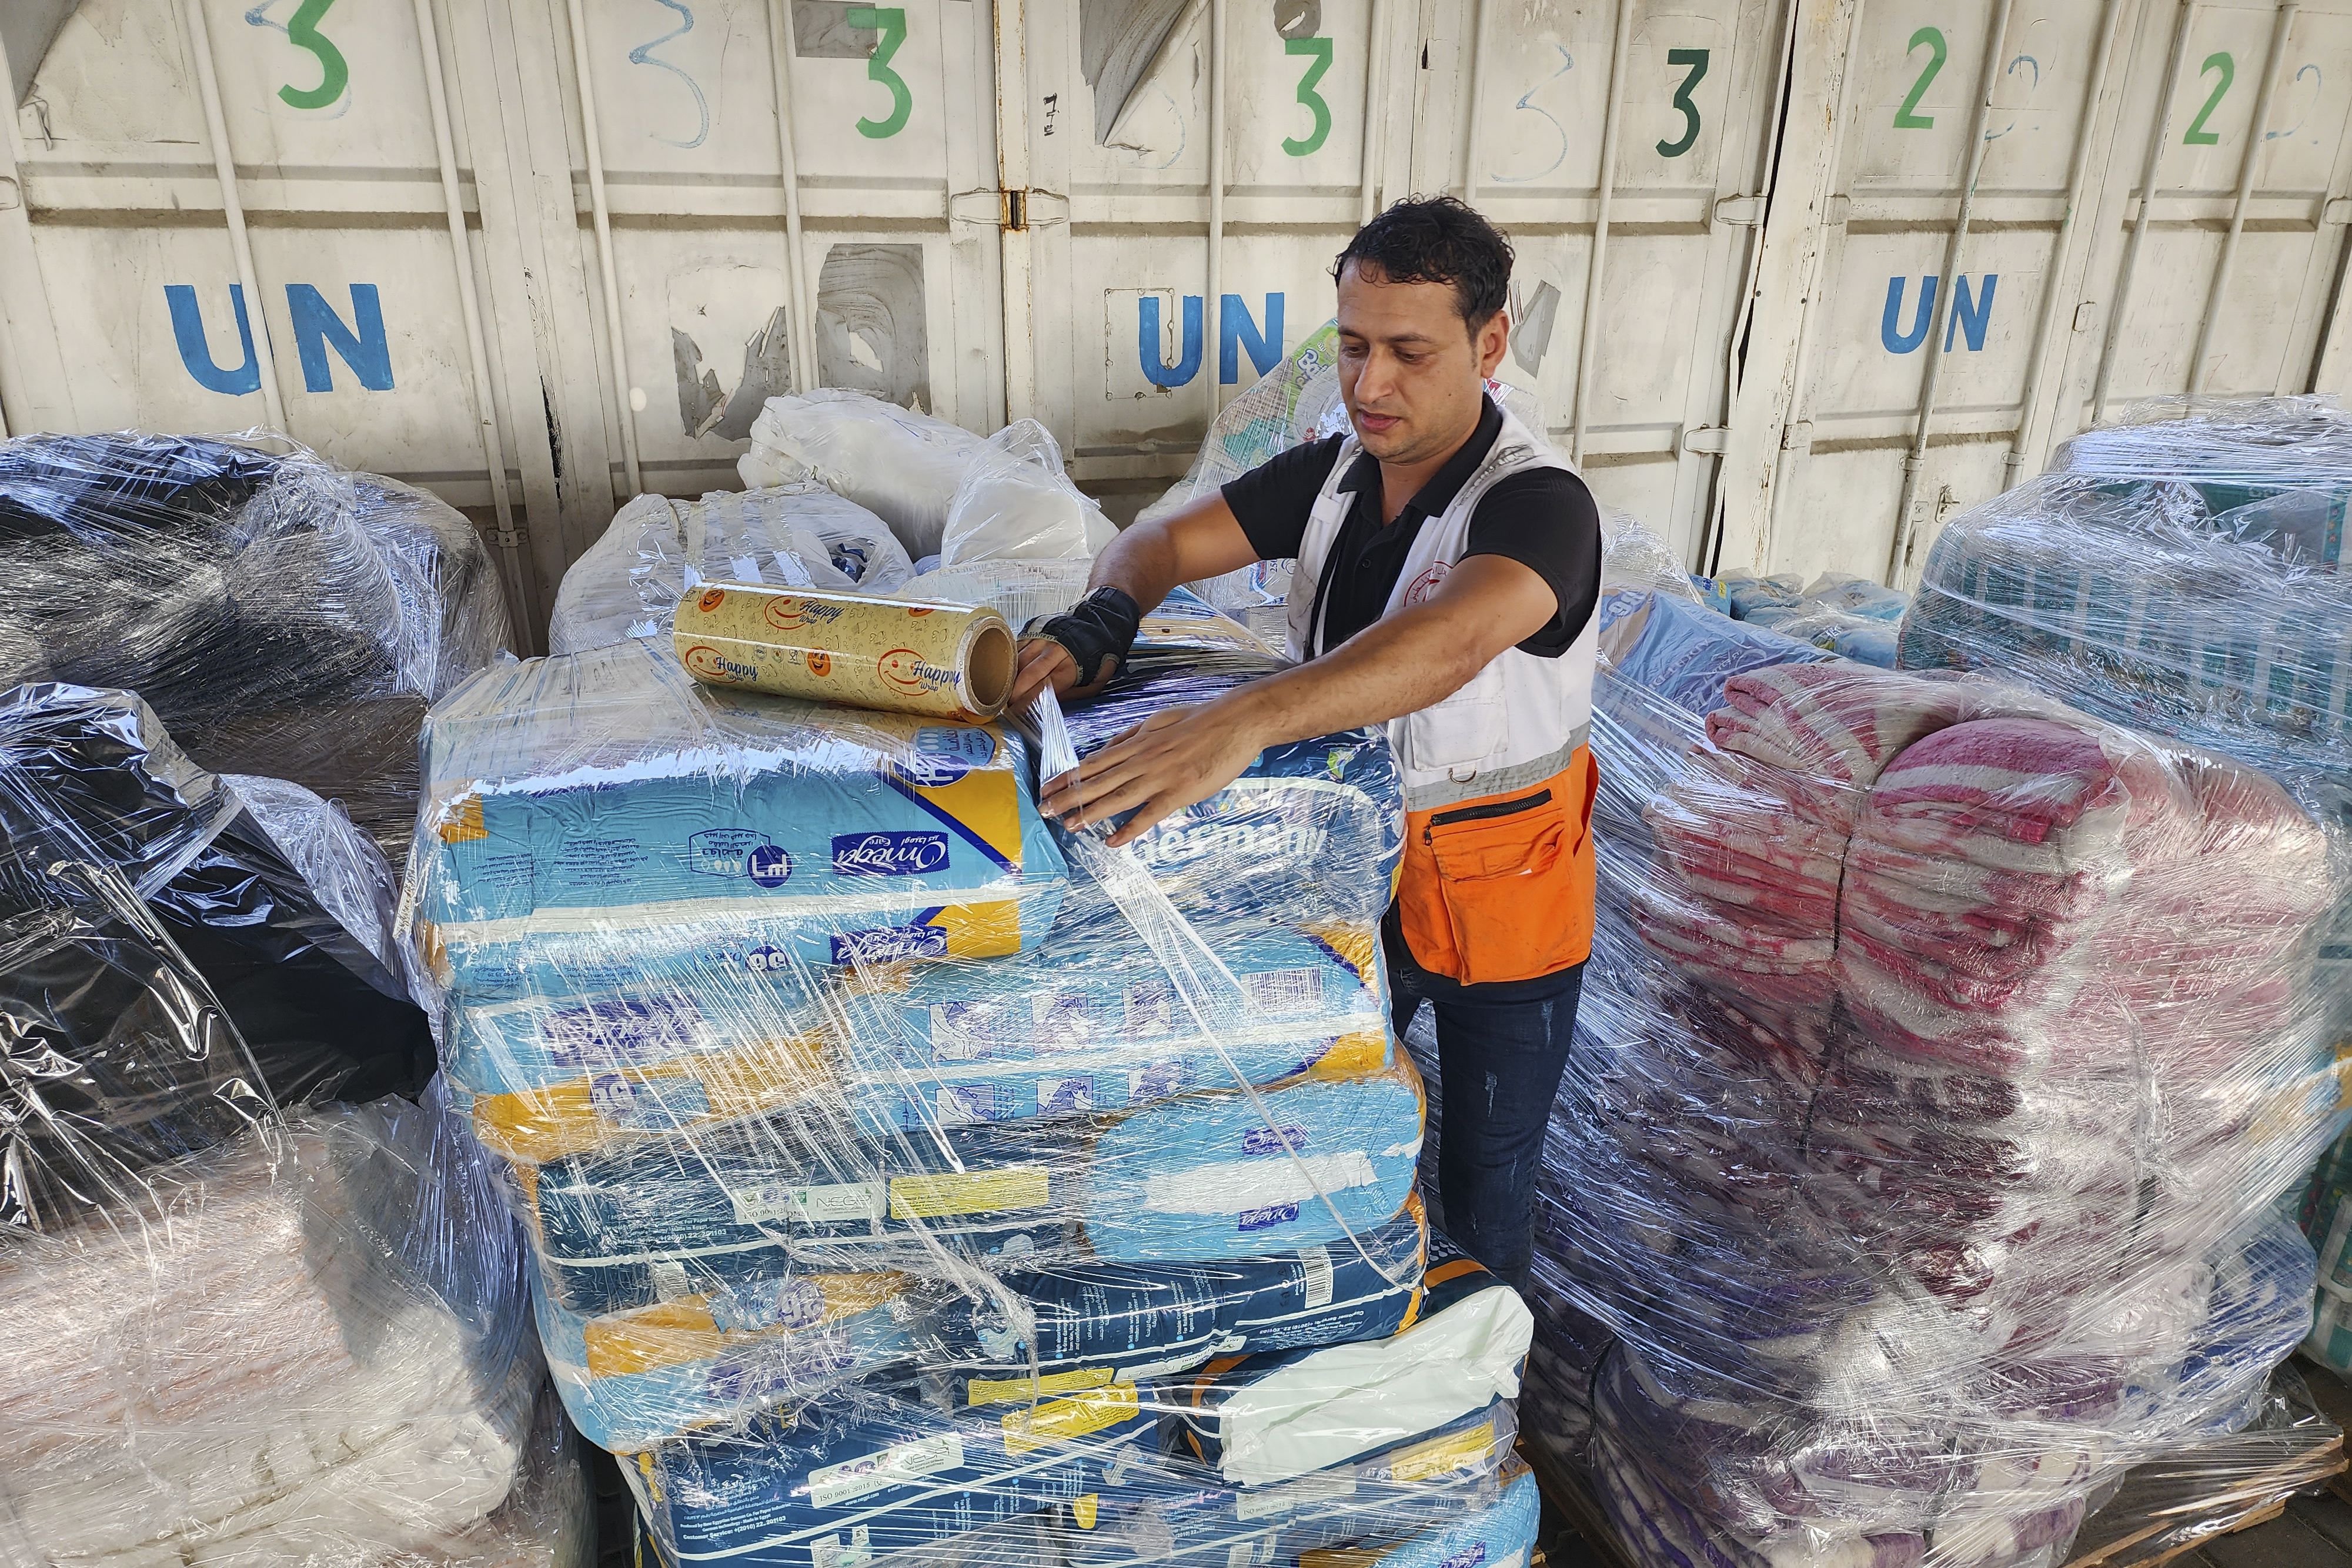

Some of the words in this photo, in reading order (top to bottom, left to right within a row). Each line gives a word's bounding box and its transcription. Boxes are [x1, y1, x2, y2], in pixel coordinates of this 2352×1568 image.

[277, 0, 348, 109] 3
[847, 8, 913, 139] 3
[1893, 27, 1947, 129] 2
[1281, 38, 1334, 157] 3
[1655, 49, 1710, 158] 3
[2183, 52, 2234, 145] 2
[1882, 274, 1999, 355] UN
[165, 283, 395, 396] UN
[1139, 292, 1285, 387] UN
[799, 615, 817, 624] Wrap
[800, 600, 846, 624] Happy
[715, 656, 759, 682] Happy
[725, 673, 744, 682] Wrap
[913, 660, 962, 690] Happy
[918, 681, 938, 691] Wrap
[751, 854, 787, 876] ٣٦
[837, 835, 946, 869] Omega
[751, 952, 787, 970] 36
[820, 1493, 833, 1502] ISO
[834, 1488, 851, 1497] 9001
[709, 1529, 733, 1539] Service:
